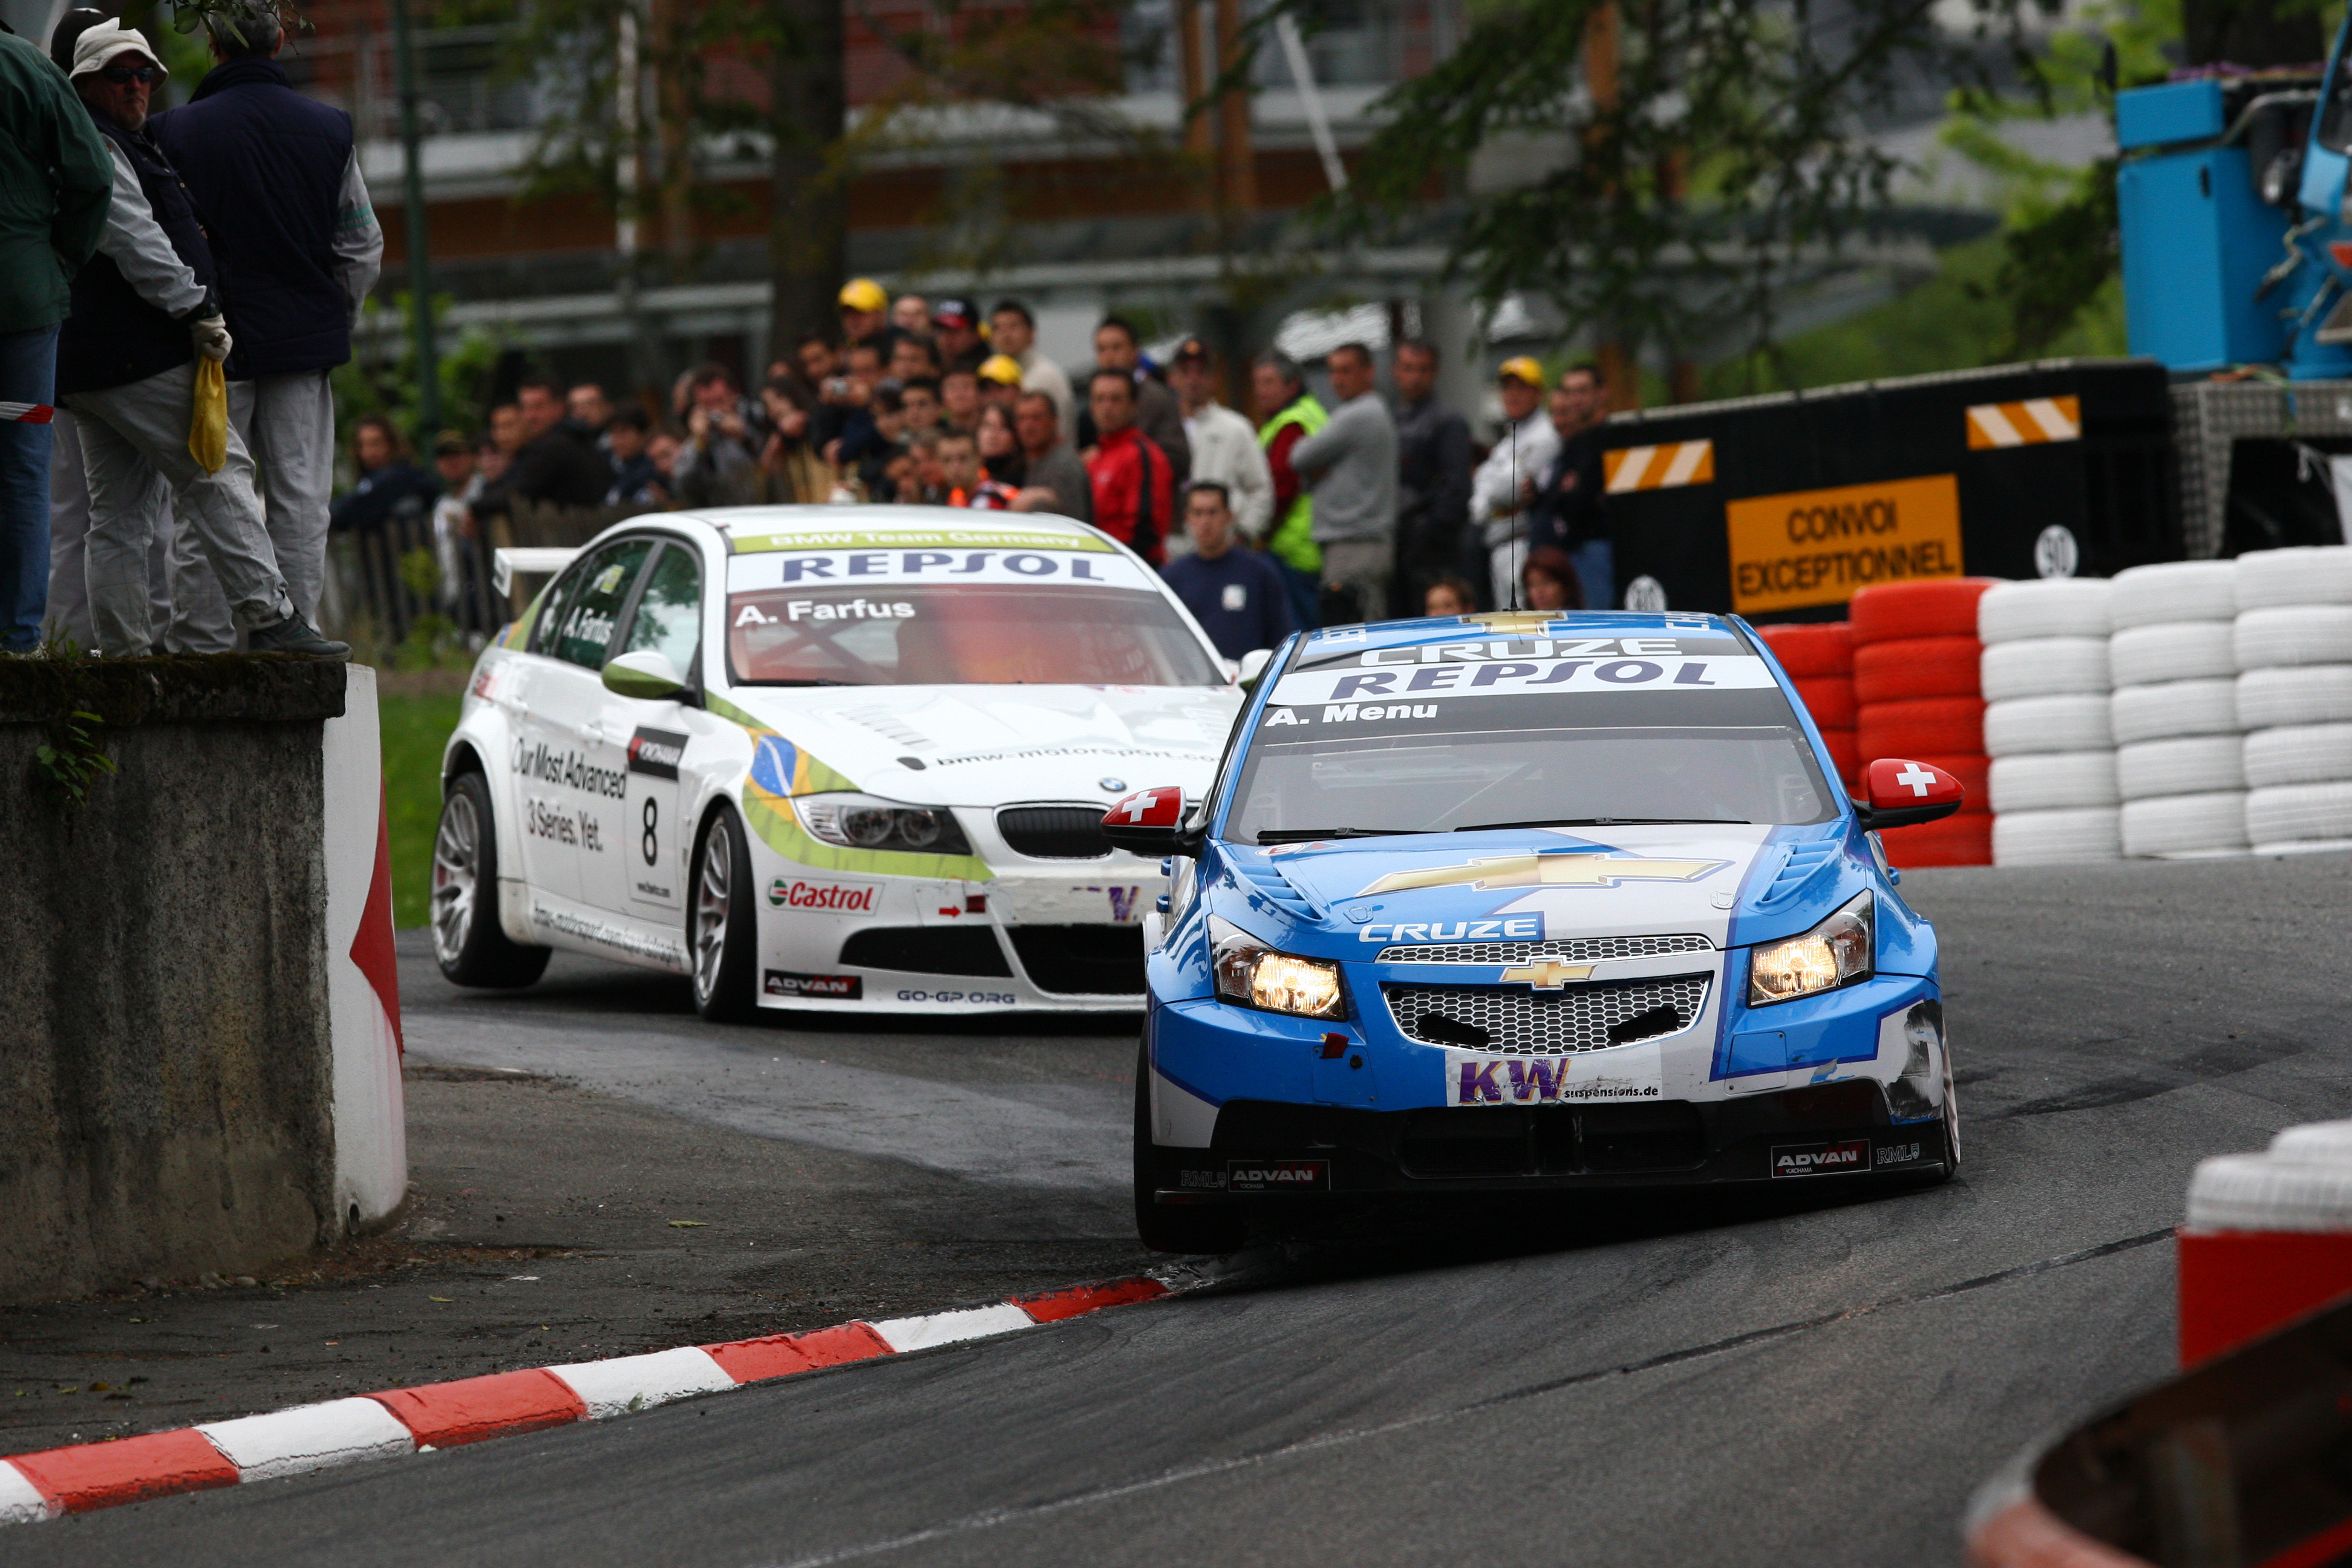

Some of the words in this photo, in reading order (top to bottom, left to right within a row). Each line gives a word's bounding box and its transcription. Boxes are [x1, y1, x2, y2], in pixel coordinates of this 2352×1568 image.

[1787, 497, 1897, 544] CONVOI
[770, 532, 852, 547] BMW
[859, 531, 943, 544] Team
[947, 531, 1080, 548] Germany
[783, 552, 1105, 583] REPSOL
[1737, 539, 1956, 597] EXCEPTIONNEL
[734, 605, 779, 627] A.
[787, 598, 916, 622] Farfus
[1361, 638, 1683, 667] CRUZE
[1328, 660, 1716, 701] REPSOL
[1264, 708, 1310, 727] A.
[1322, 704, 1439, 724] Menu
[512, 736, 534, 776] Our
[534, 742, 565, 784] Most
[563, 750, 629, 800] Advanced
[936, 746, 1221, 766] bmw-motorsport.co
[527, 798, 535, 835] 3
[643, 795, 658, 866] 8
[789, 881, 874, 911] Castrol
[1358, 918, 1538, 942] CRUZE
[767, 976, 848, 993] ADVAN
[897, 989, 1016, 1005] GO-GP.ORG
[1459, 1057, 1571, 1105] KW
[1564, 1086, 1659, 1099] suspensions.de
[1776, 1150, 1858, 1167] ADVAN
[1877, 1144, 1912, 1165] RML
[1181, 1170, 1218, 1188] RML
[1232, 1170, 1313, 1181] ADVAN
